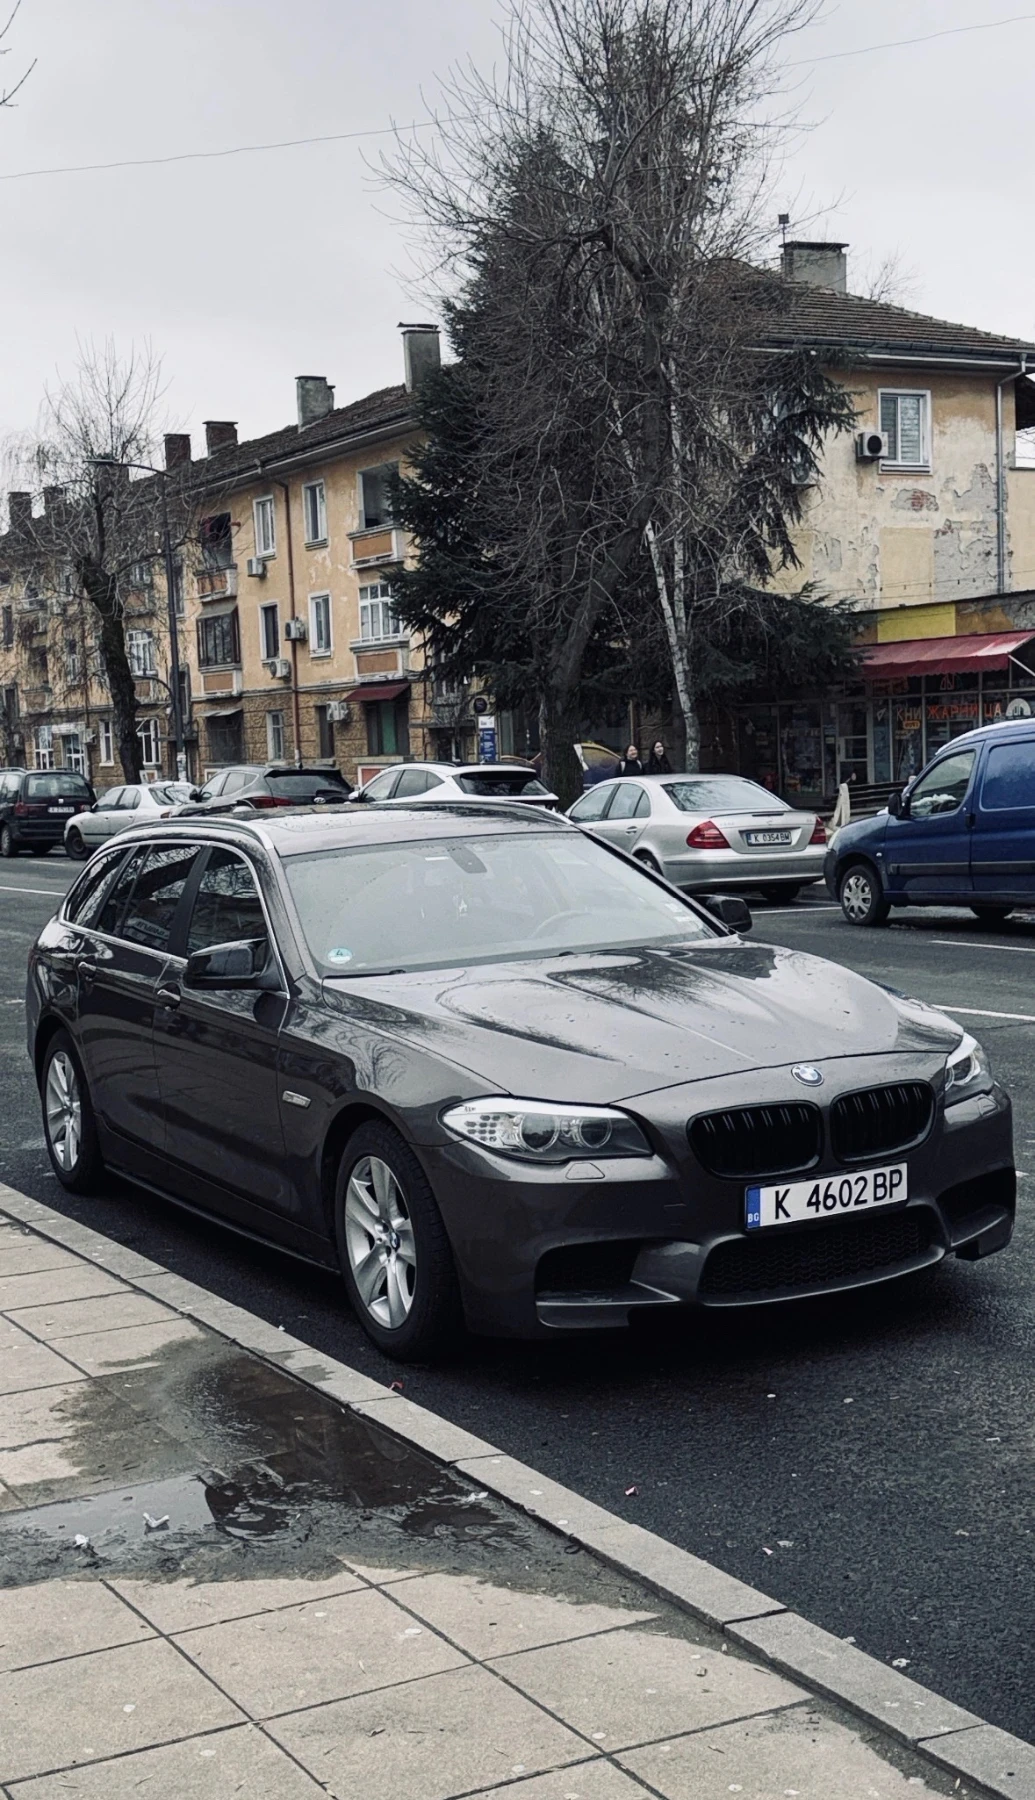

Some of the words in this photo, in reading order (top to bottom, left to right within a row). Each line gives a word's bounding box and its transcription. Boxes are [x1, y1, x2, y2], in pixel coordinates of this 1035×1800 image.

[753, 834, 760, 842] K
[775, 1188, 791, 1220] K
[747, 1212, 760, 1223] BG
